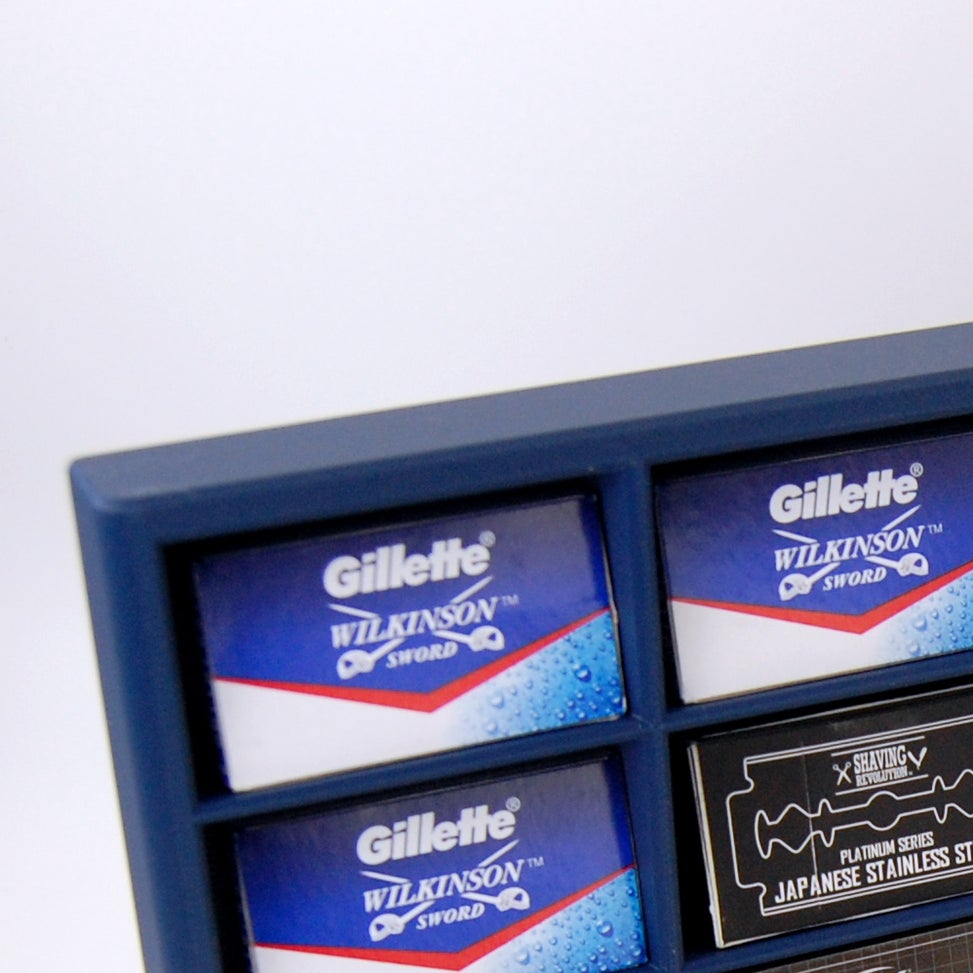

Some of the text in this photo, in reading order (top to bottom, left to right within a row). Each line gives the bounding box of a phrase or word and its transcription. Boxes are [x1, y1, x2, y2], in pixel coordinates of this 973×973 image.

[775, 524, 924, 571] WILKINSON
[823, 566, 886, 591] SWORD
[329, 594, 499, 649] WILKINSON
[386, 639, 458, 669] SWORD
[853, 745, 907, 774] SHAVING
[856, 765, 909, 787] REVOLUTION
[841, 831, 934, 865] PLATINUM SERIES
[362, 859, 525, 913] WILKINSON
[774, 866, 861, 904] JAPANESE
[866, 846, 950, 883] STAINLESS
[417, 902, 485, 930] SWORD
